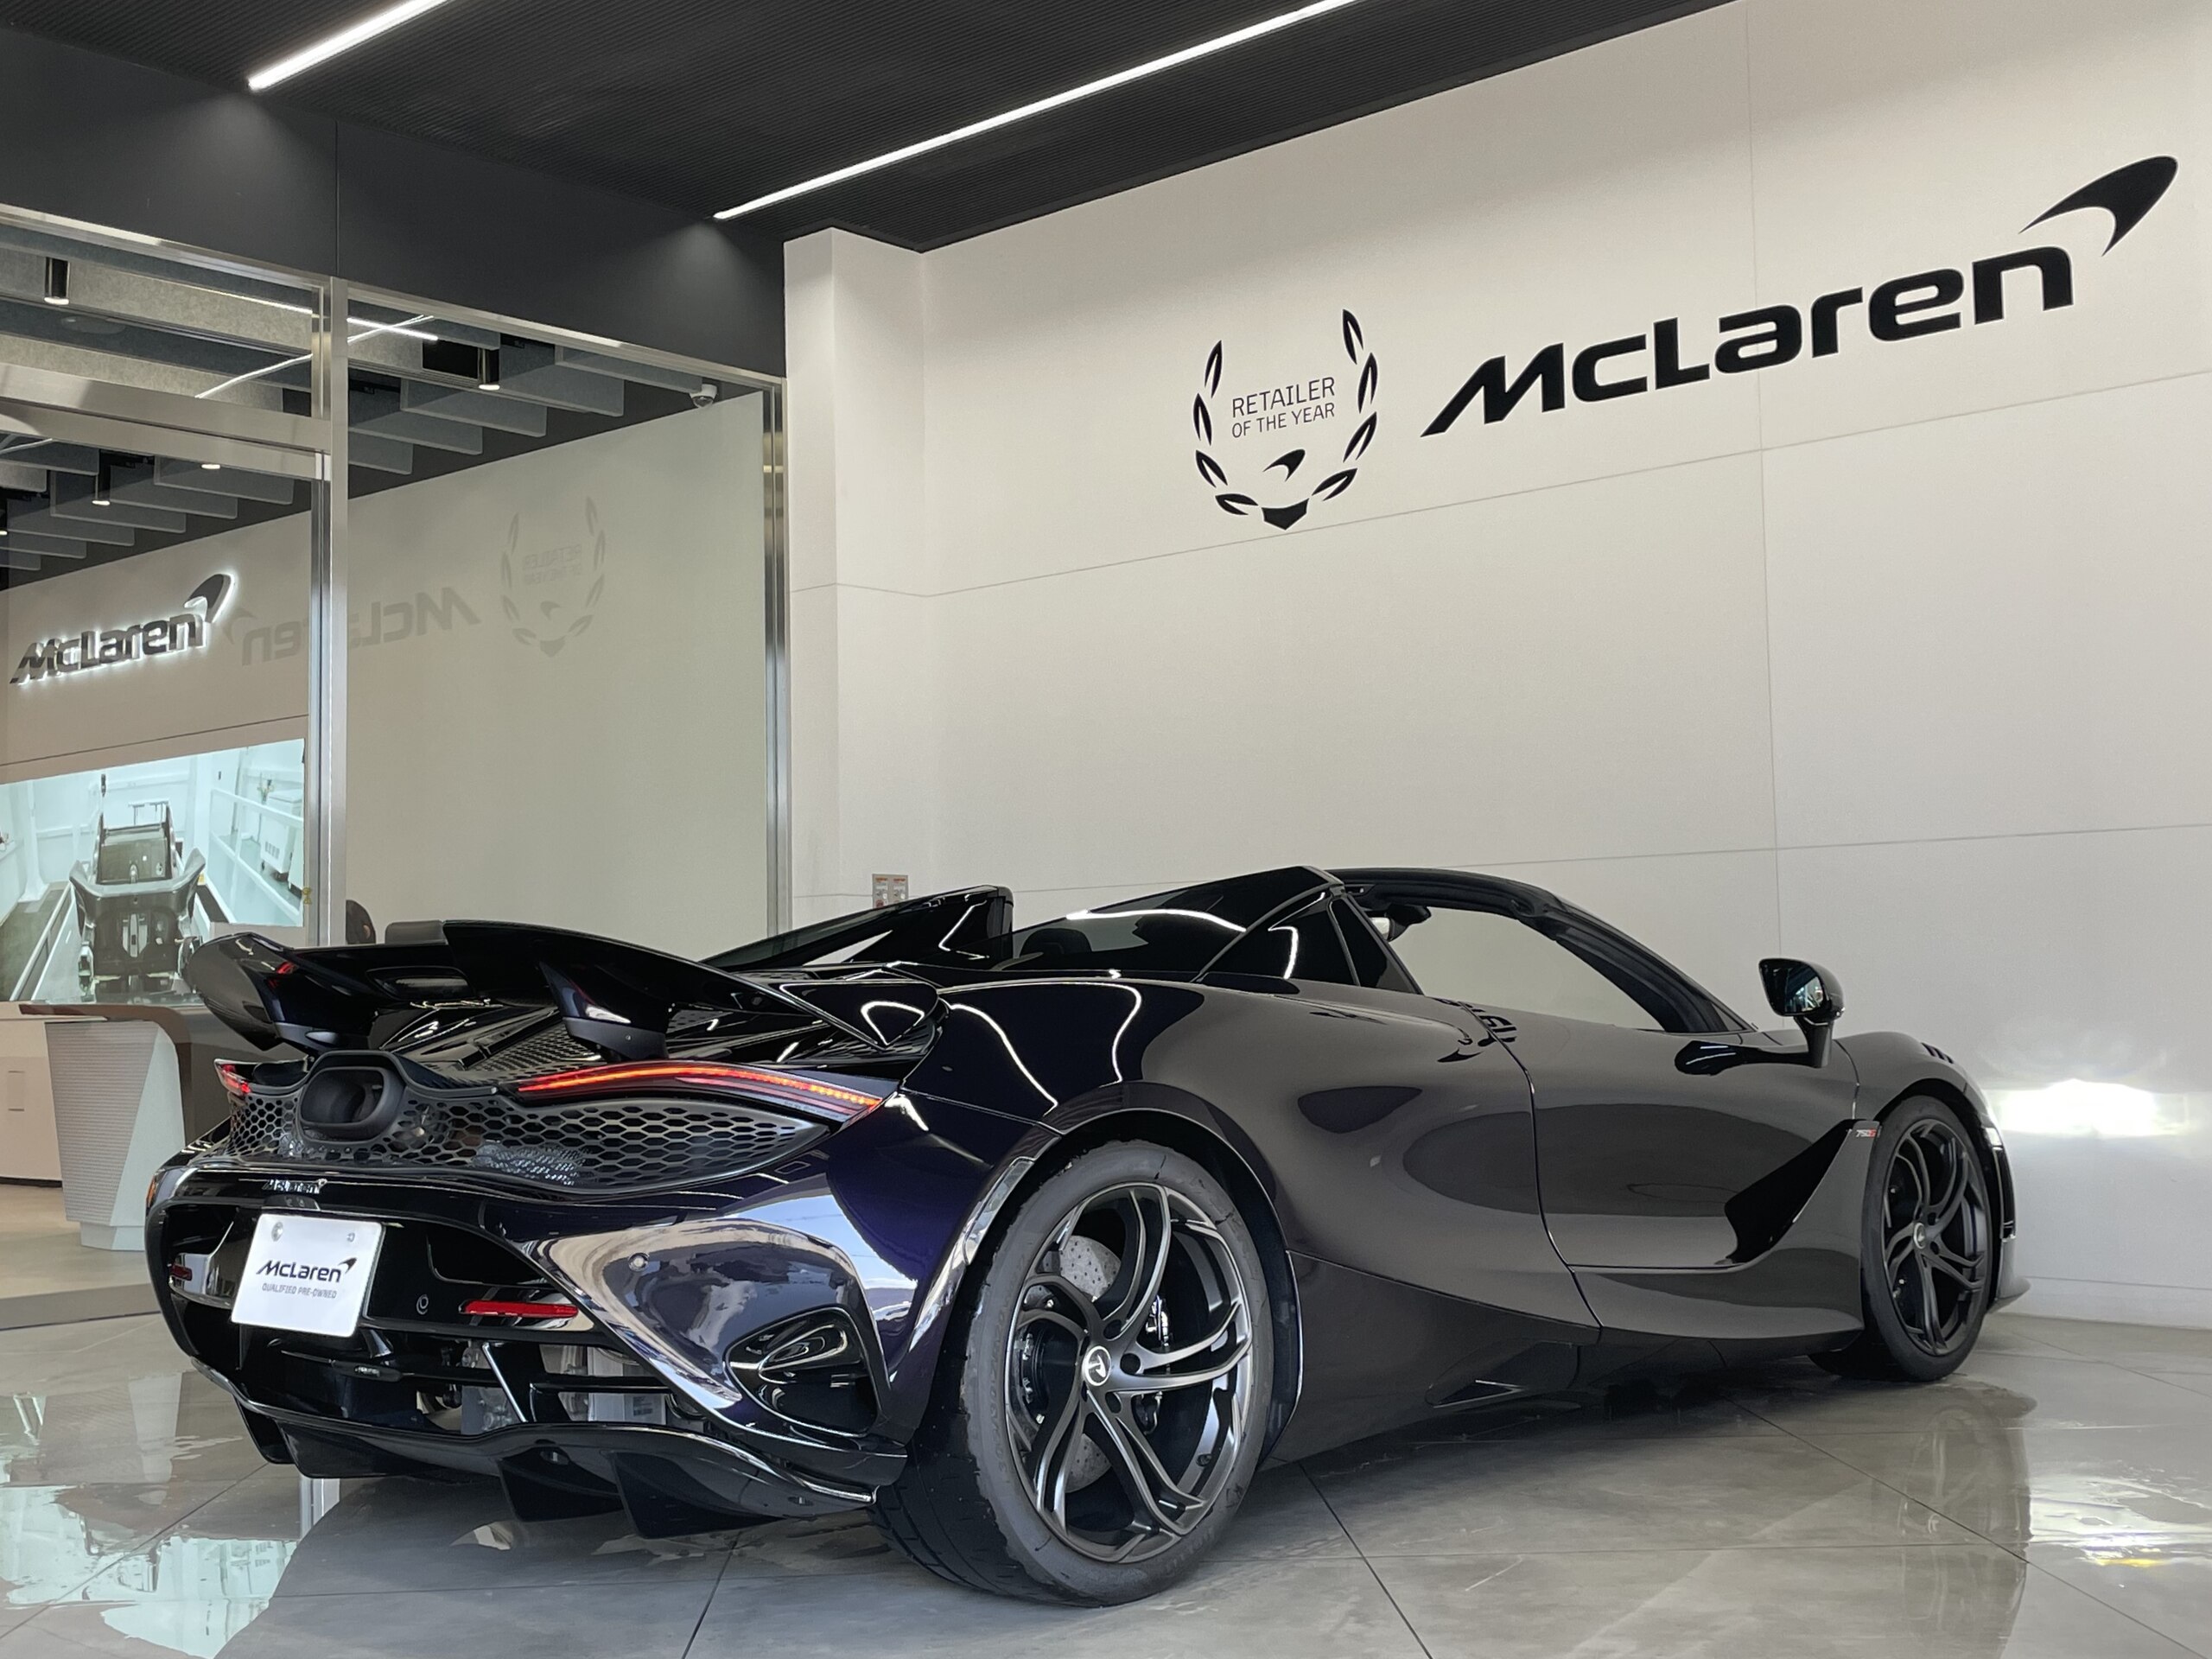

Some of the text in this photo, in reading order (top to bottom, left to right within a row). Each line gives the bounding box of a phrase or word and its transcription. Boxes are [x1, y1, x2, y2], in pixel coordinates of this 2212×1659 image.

[1421, 246, 2074, 438] McLaren
[1232, 377, 1335, 418] RETAILER
[1232, 402, 1335, 438] OF THE YEAR
[10, 613, 207, 684] McLaren
[256, 1260, 341, 1283] McLaren
[262, 1282, 337, 1299] QUALIFIED PRE-OWNED
